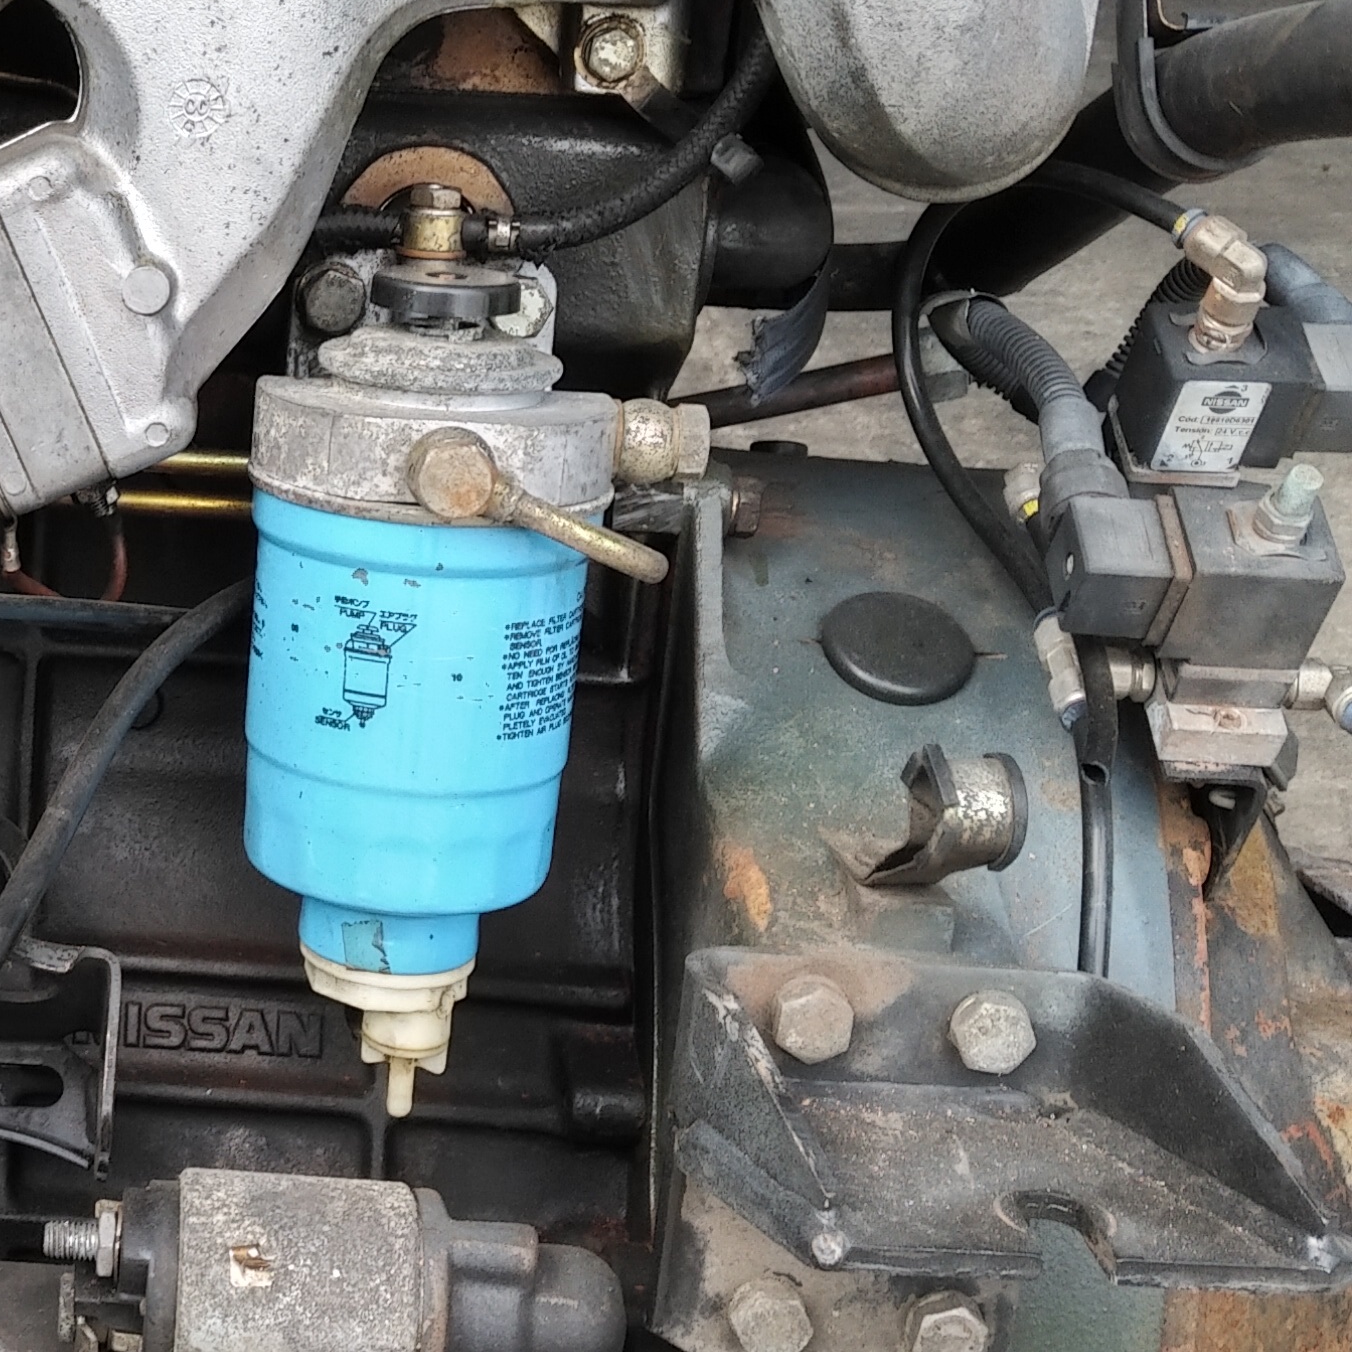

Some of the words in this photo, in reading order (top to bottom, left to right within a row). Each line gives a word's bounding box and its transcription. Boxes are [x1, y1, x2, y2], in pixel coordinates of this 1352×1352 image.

[1203, 397, 1248, 407] NISSAN
[339, 607, 365, 619] PUMP
[380, 620, 407, 633] PLUG
[523, 648, 543, 659] NEED
[314, 715, 351, 732] SENSOR
[123, 999, 323, 1060] ISSAN
